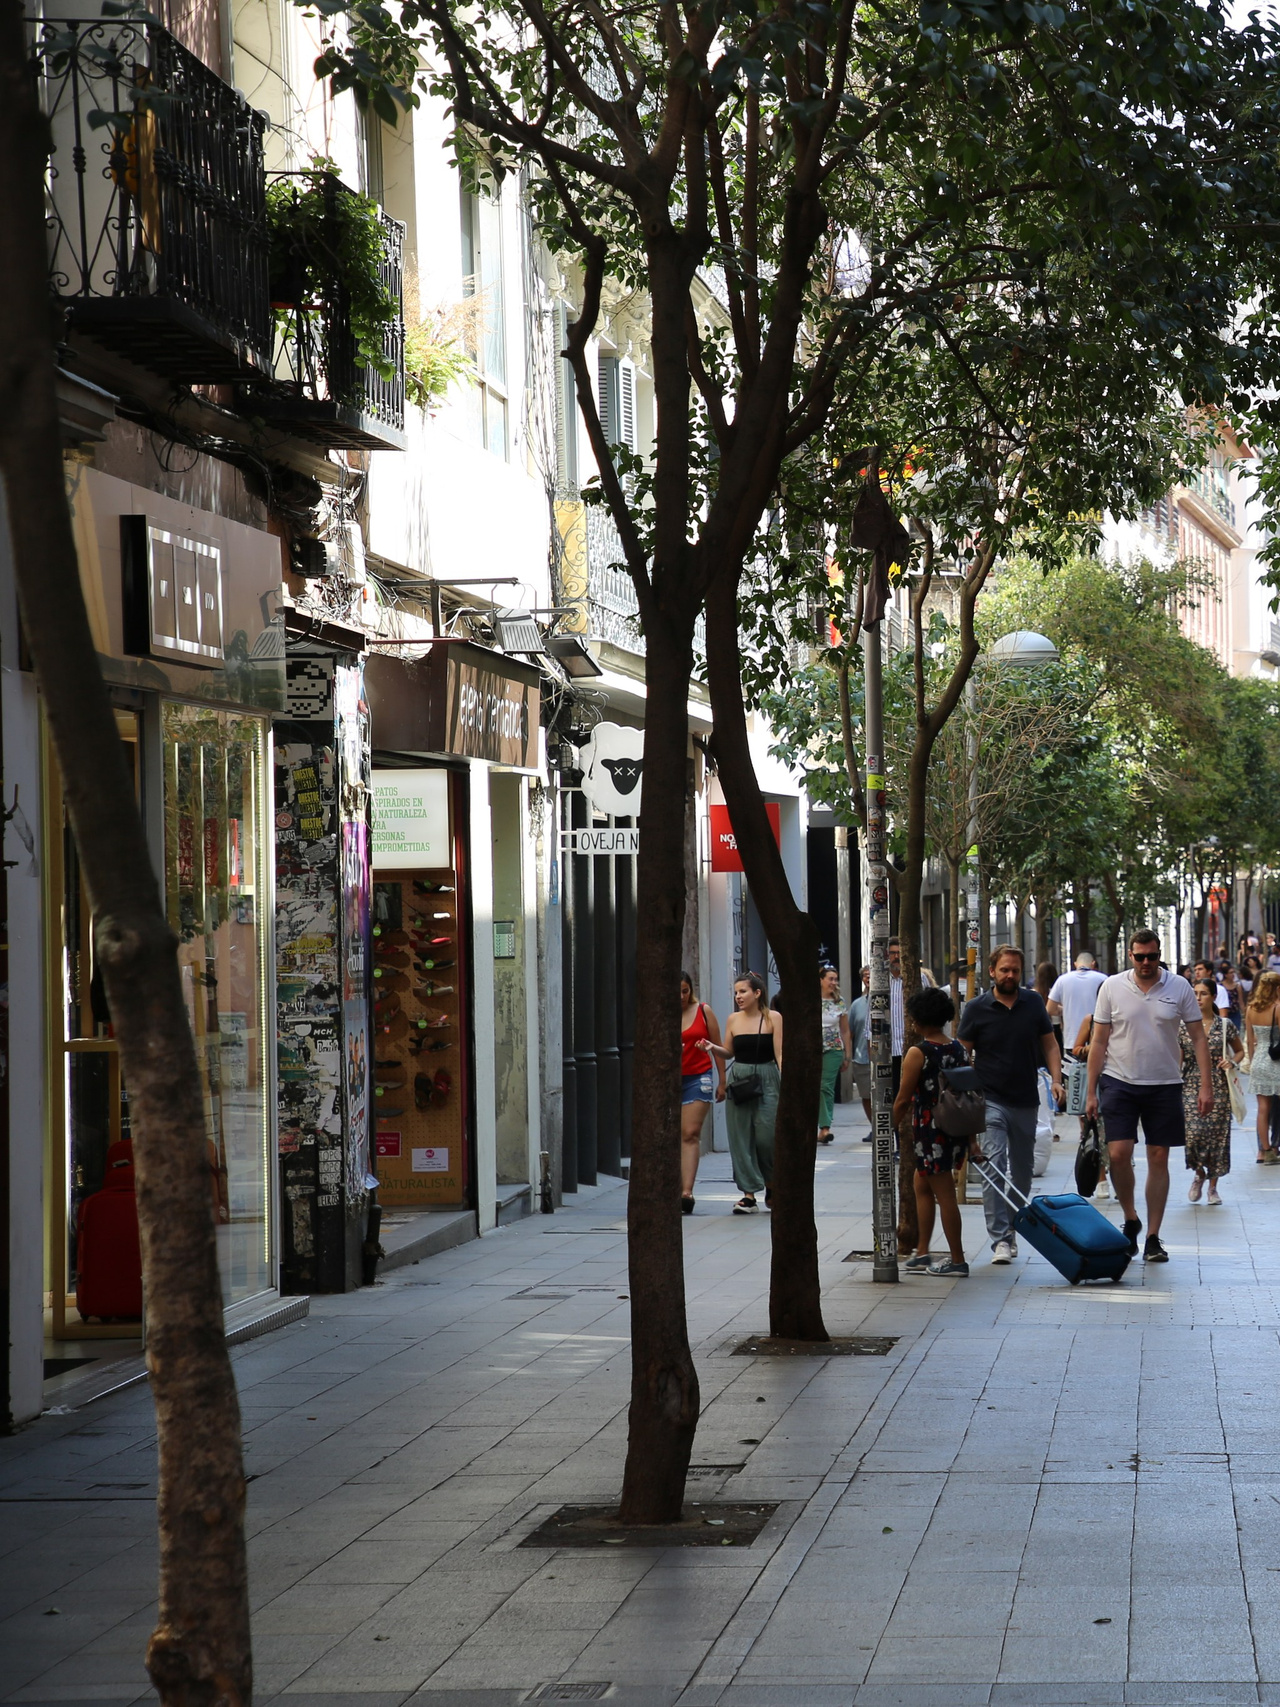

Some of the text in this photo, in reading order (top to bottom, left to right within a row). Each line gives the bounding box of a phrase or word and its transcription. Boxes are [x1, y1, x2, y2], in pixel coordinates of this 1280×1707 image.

[412, 798, 423, 807] EN
[378, 809, 427, 819] NATURALEZA
[372, 832, 405, 841] ERSONAS
[580, 832, 639, 851] OVEJA N
[371, 843, 430, 853] OMPROMETIDAS
[877, 1113, 890, 1135] BNE
[877, 1139, 890, 1161] BNE
[878, 1166, 891, 1187] BNE
[379, 1178, 456, 1190] NATURALISTA
[881, 1241, 895, 1257] 54
